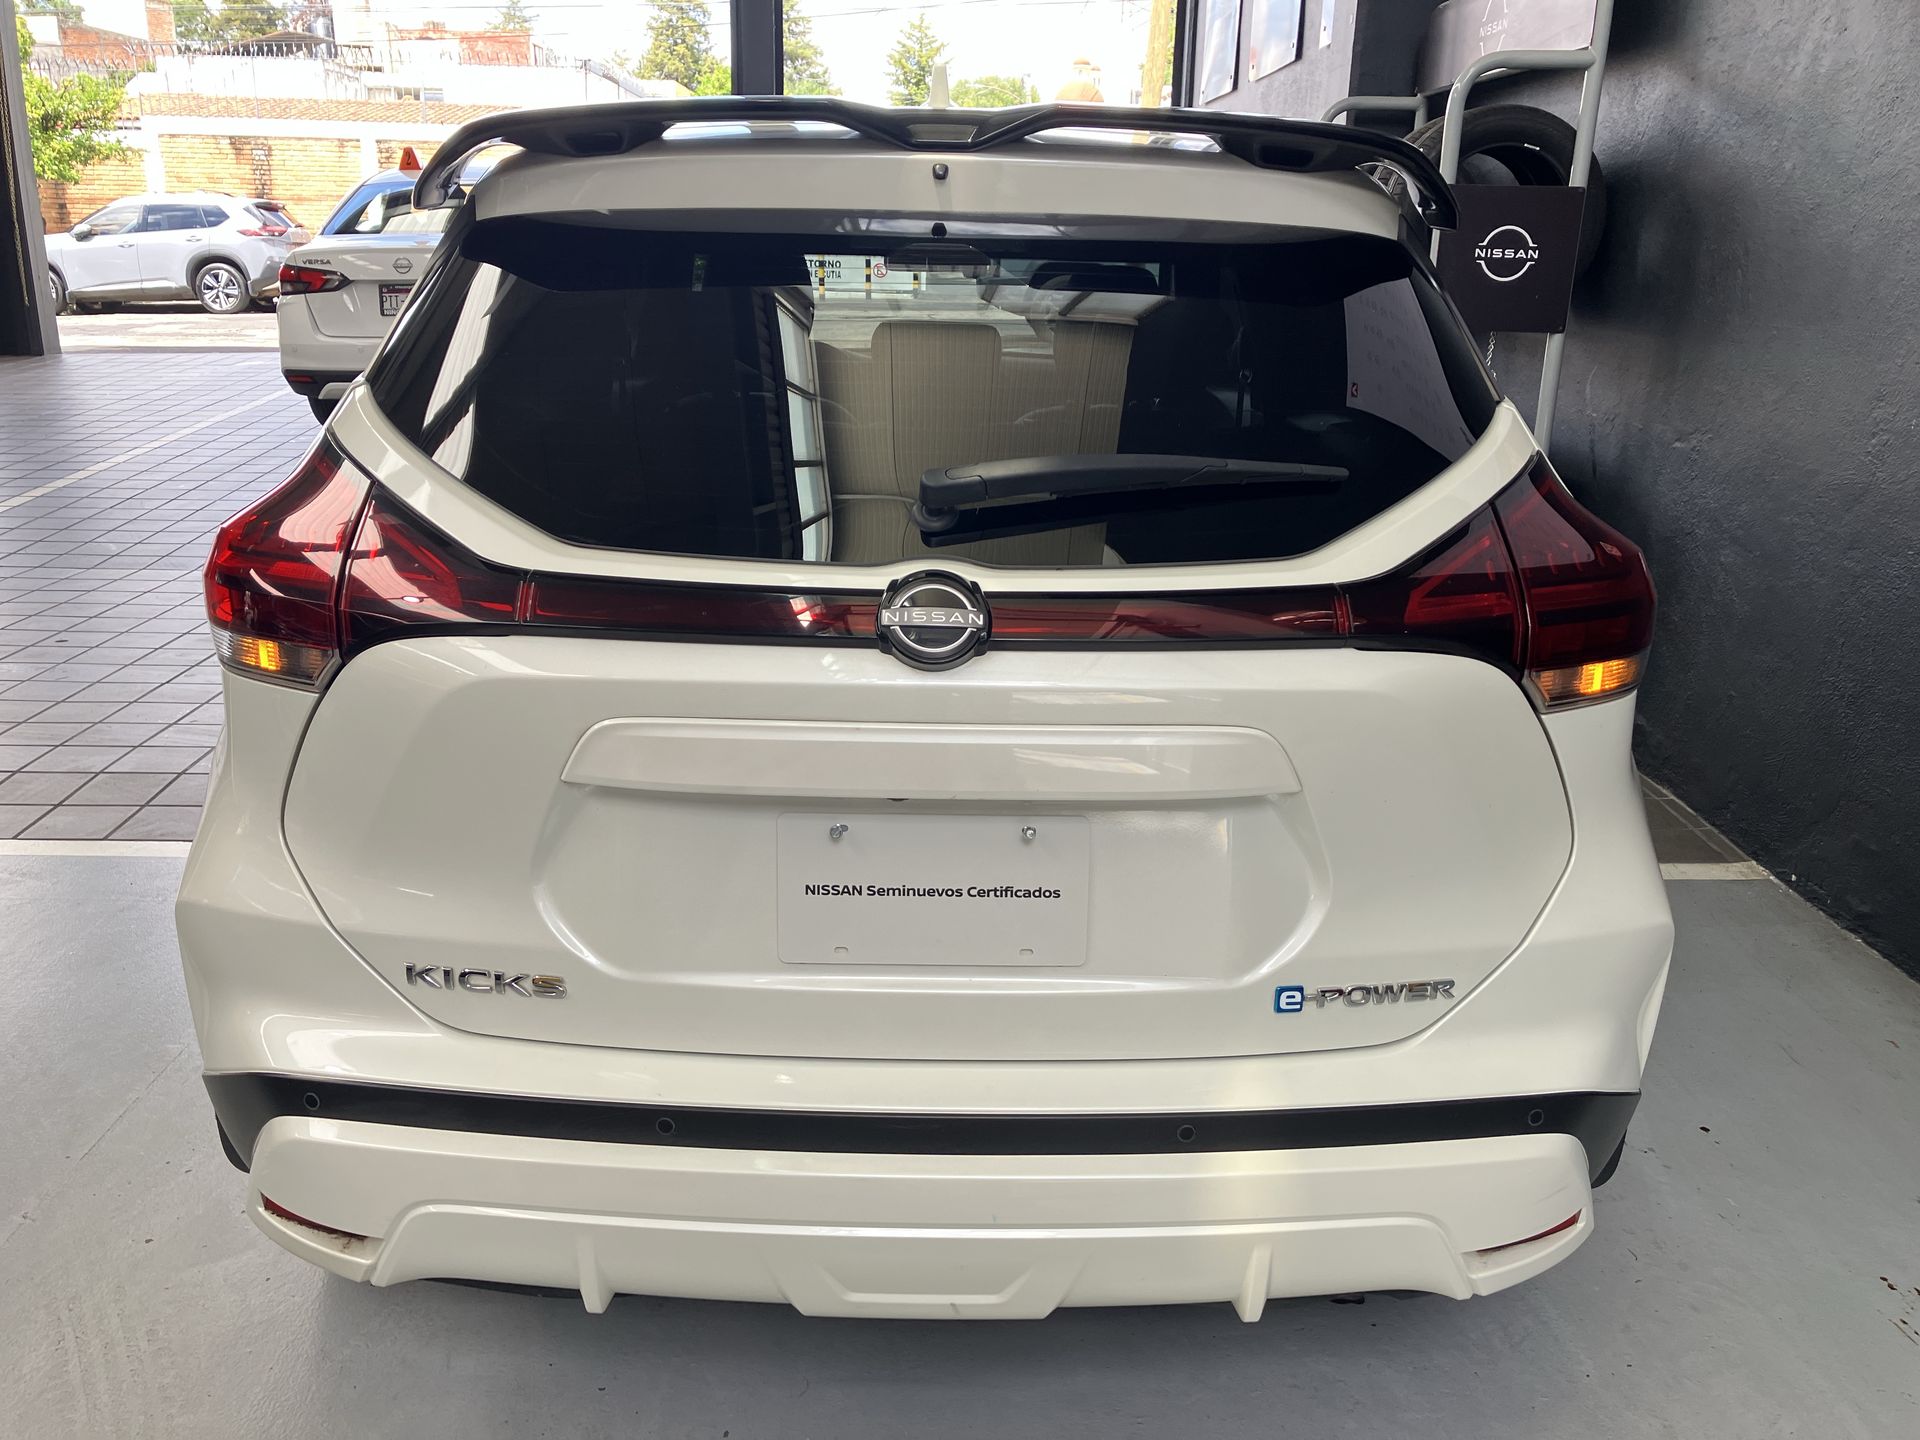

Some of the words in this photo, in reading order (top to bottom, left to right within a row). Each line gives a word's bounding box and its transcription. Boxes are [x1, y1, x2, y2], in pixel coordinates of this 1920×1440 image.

[1479, 18, 1508, 37] NISSAN
[405, 151, 412, 165] 2
[1474, 248, 1539, 259] NISSAN
[884, 611, 984, 625] NISSAN
[804, 884, 863, 896] NISSAN
[866, 884, 963, 898] Seminuevos
[966, 886, 1061, 899] Certificados
[403, 961, 568, 1000] KICKS
